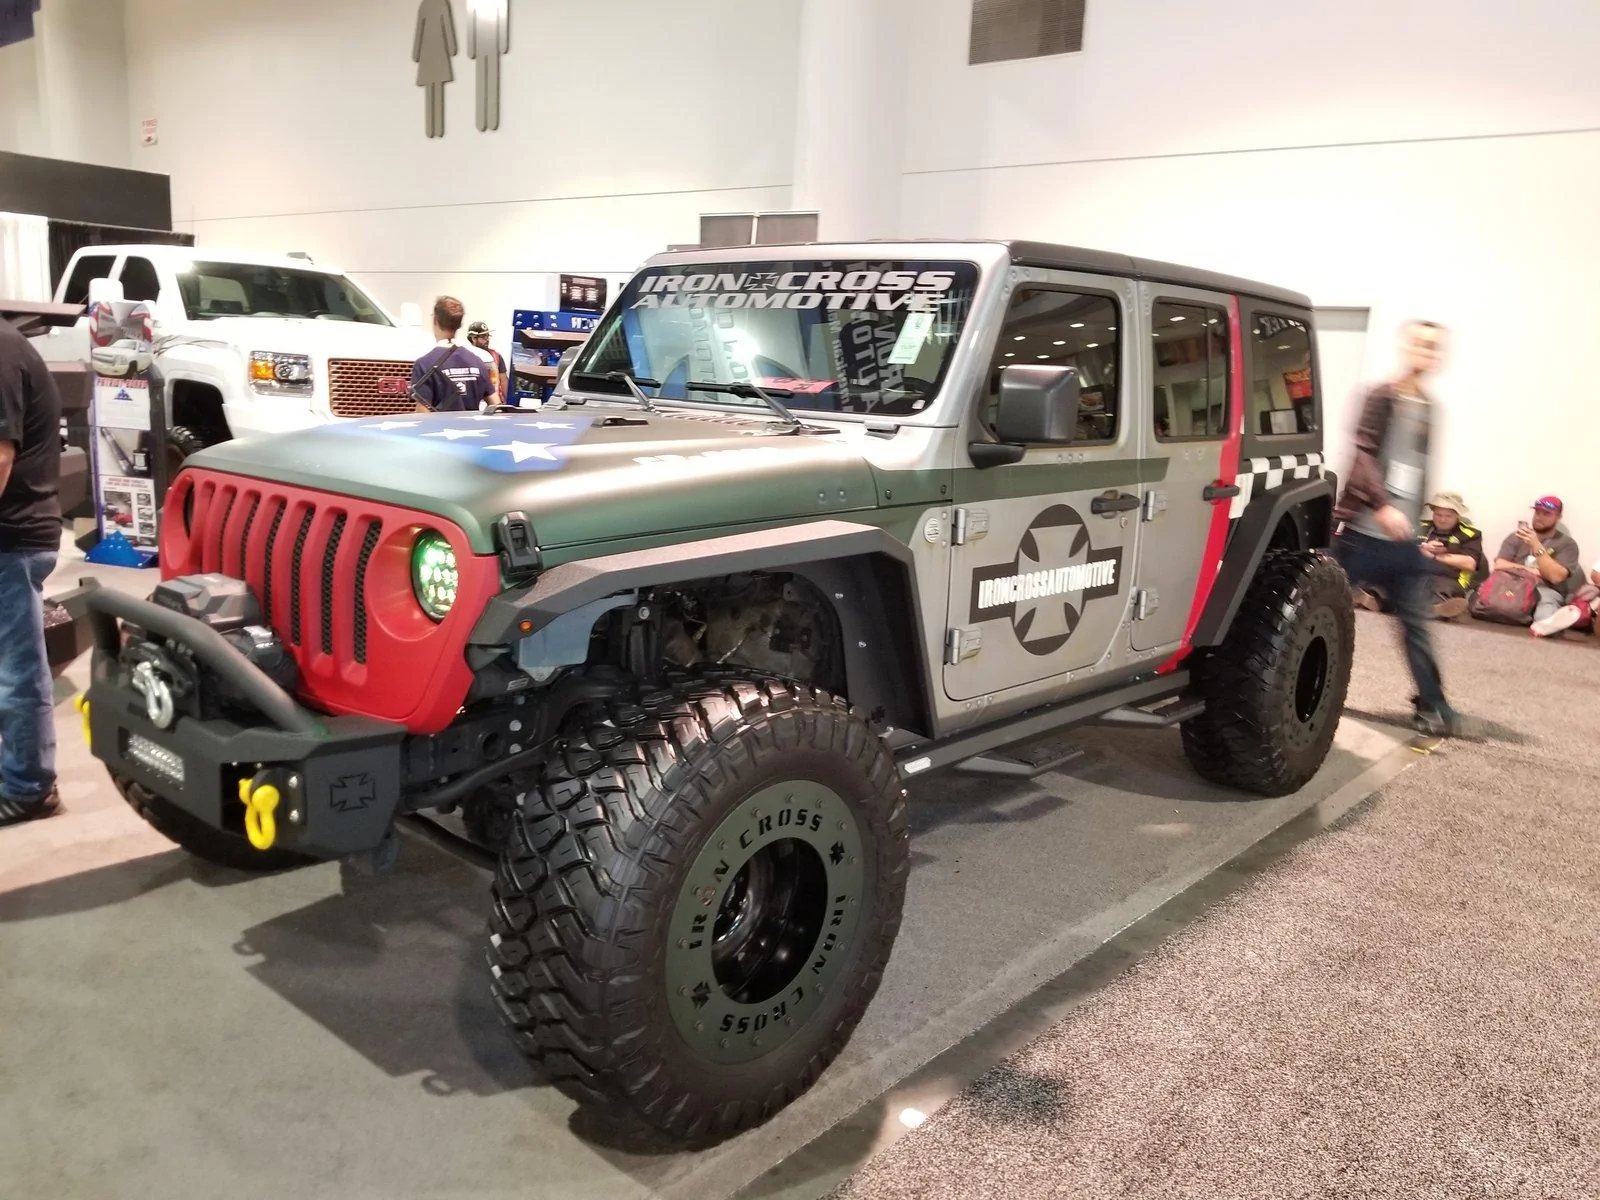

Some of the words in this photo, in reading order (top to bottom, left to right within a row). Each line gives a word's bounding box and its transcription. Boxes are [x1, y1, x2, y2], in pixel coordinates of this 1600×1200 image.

[630, 292, 946, 312] AUTOMOTIVE
[638, 272, 749, 293] IRON
[776, 270, 956, 292] CROSS
[978, 558, 1117, 609] IRONCROSSAUTOMOTIVE
[689, 859, 730, 949] IRON
[739, 808, 823, 849] CROSS
[812, 895, 846, 975] IRON
[720, 986, 804, 1034] CROSS
